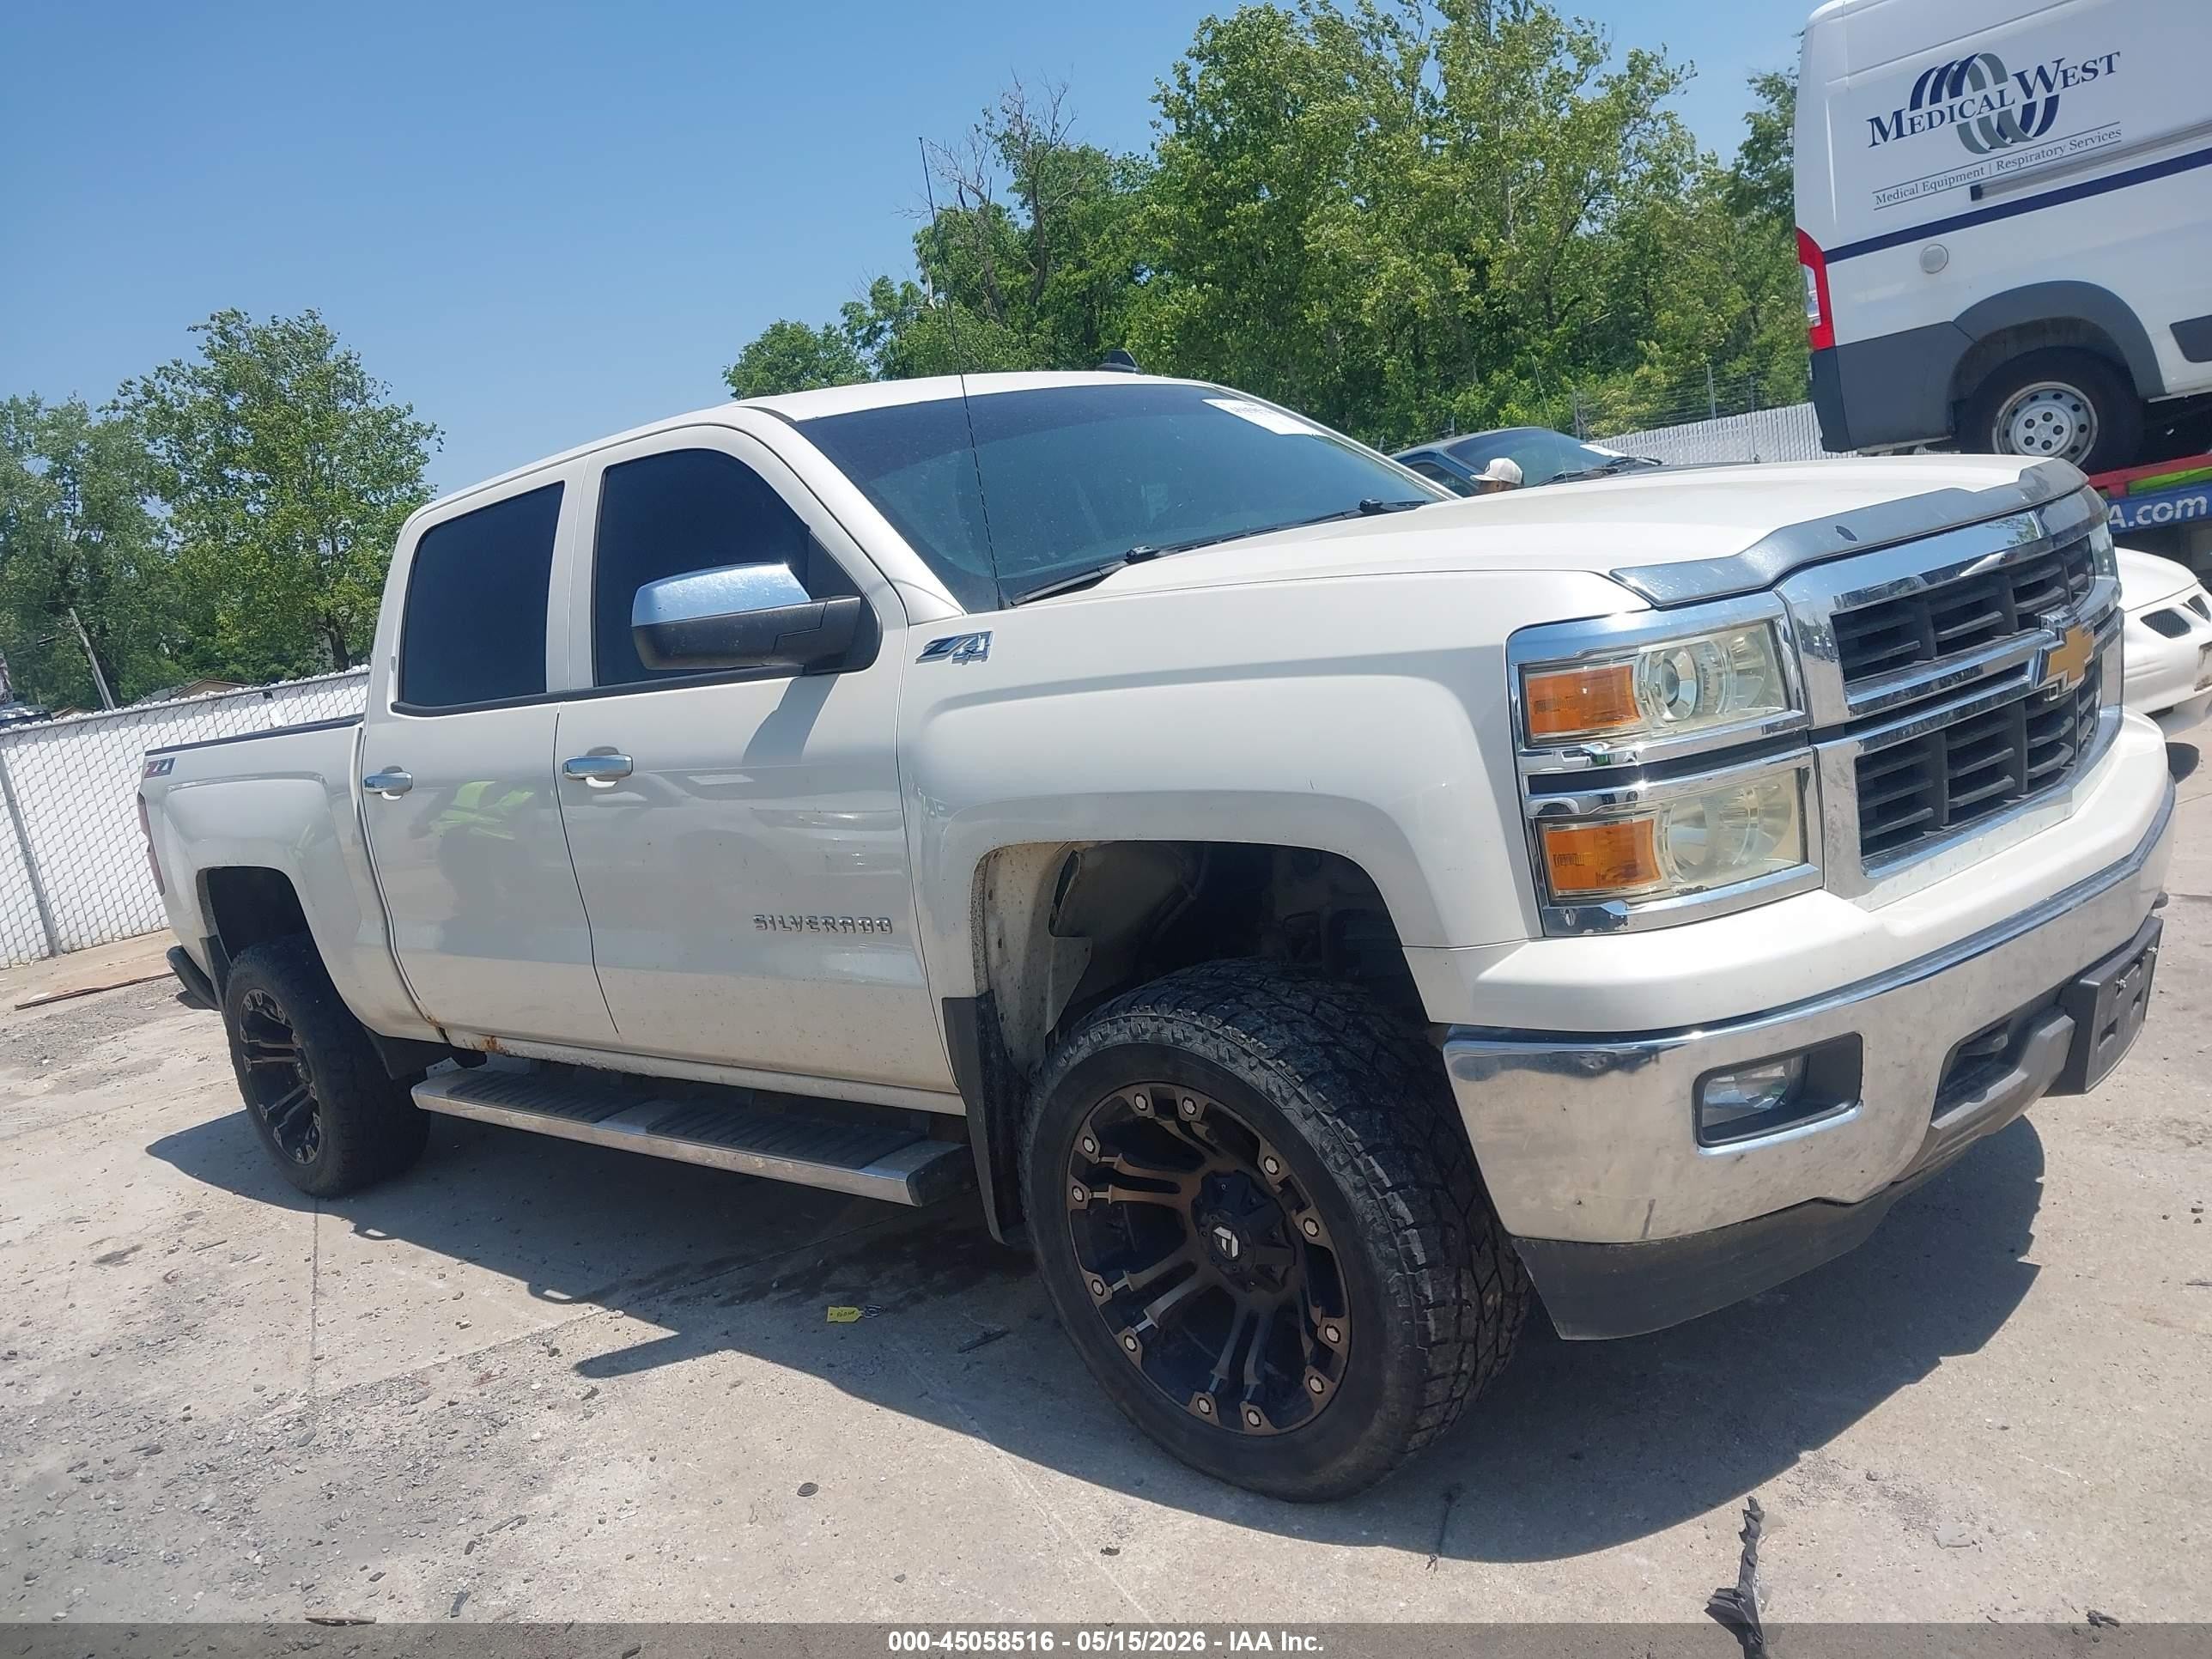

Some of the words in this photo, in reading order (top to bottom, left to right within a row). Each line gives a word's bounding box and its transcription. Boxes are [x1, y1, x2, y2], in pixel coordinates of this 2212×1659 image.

[1866, 88, 2015, 148] MEDICAL
[2012, 52, 2121, 100] WEST
[1875, 184, 1920, 205] Medical
[1923, 167, 1985, 191] Equipment
[1996, 144, 2065, 171] Respiratory
[2069, 129, 2122, 152] Services
[753, 914, 893, 934] SILVERADO
